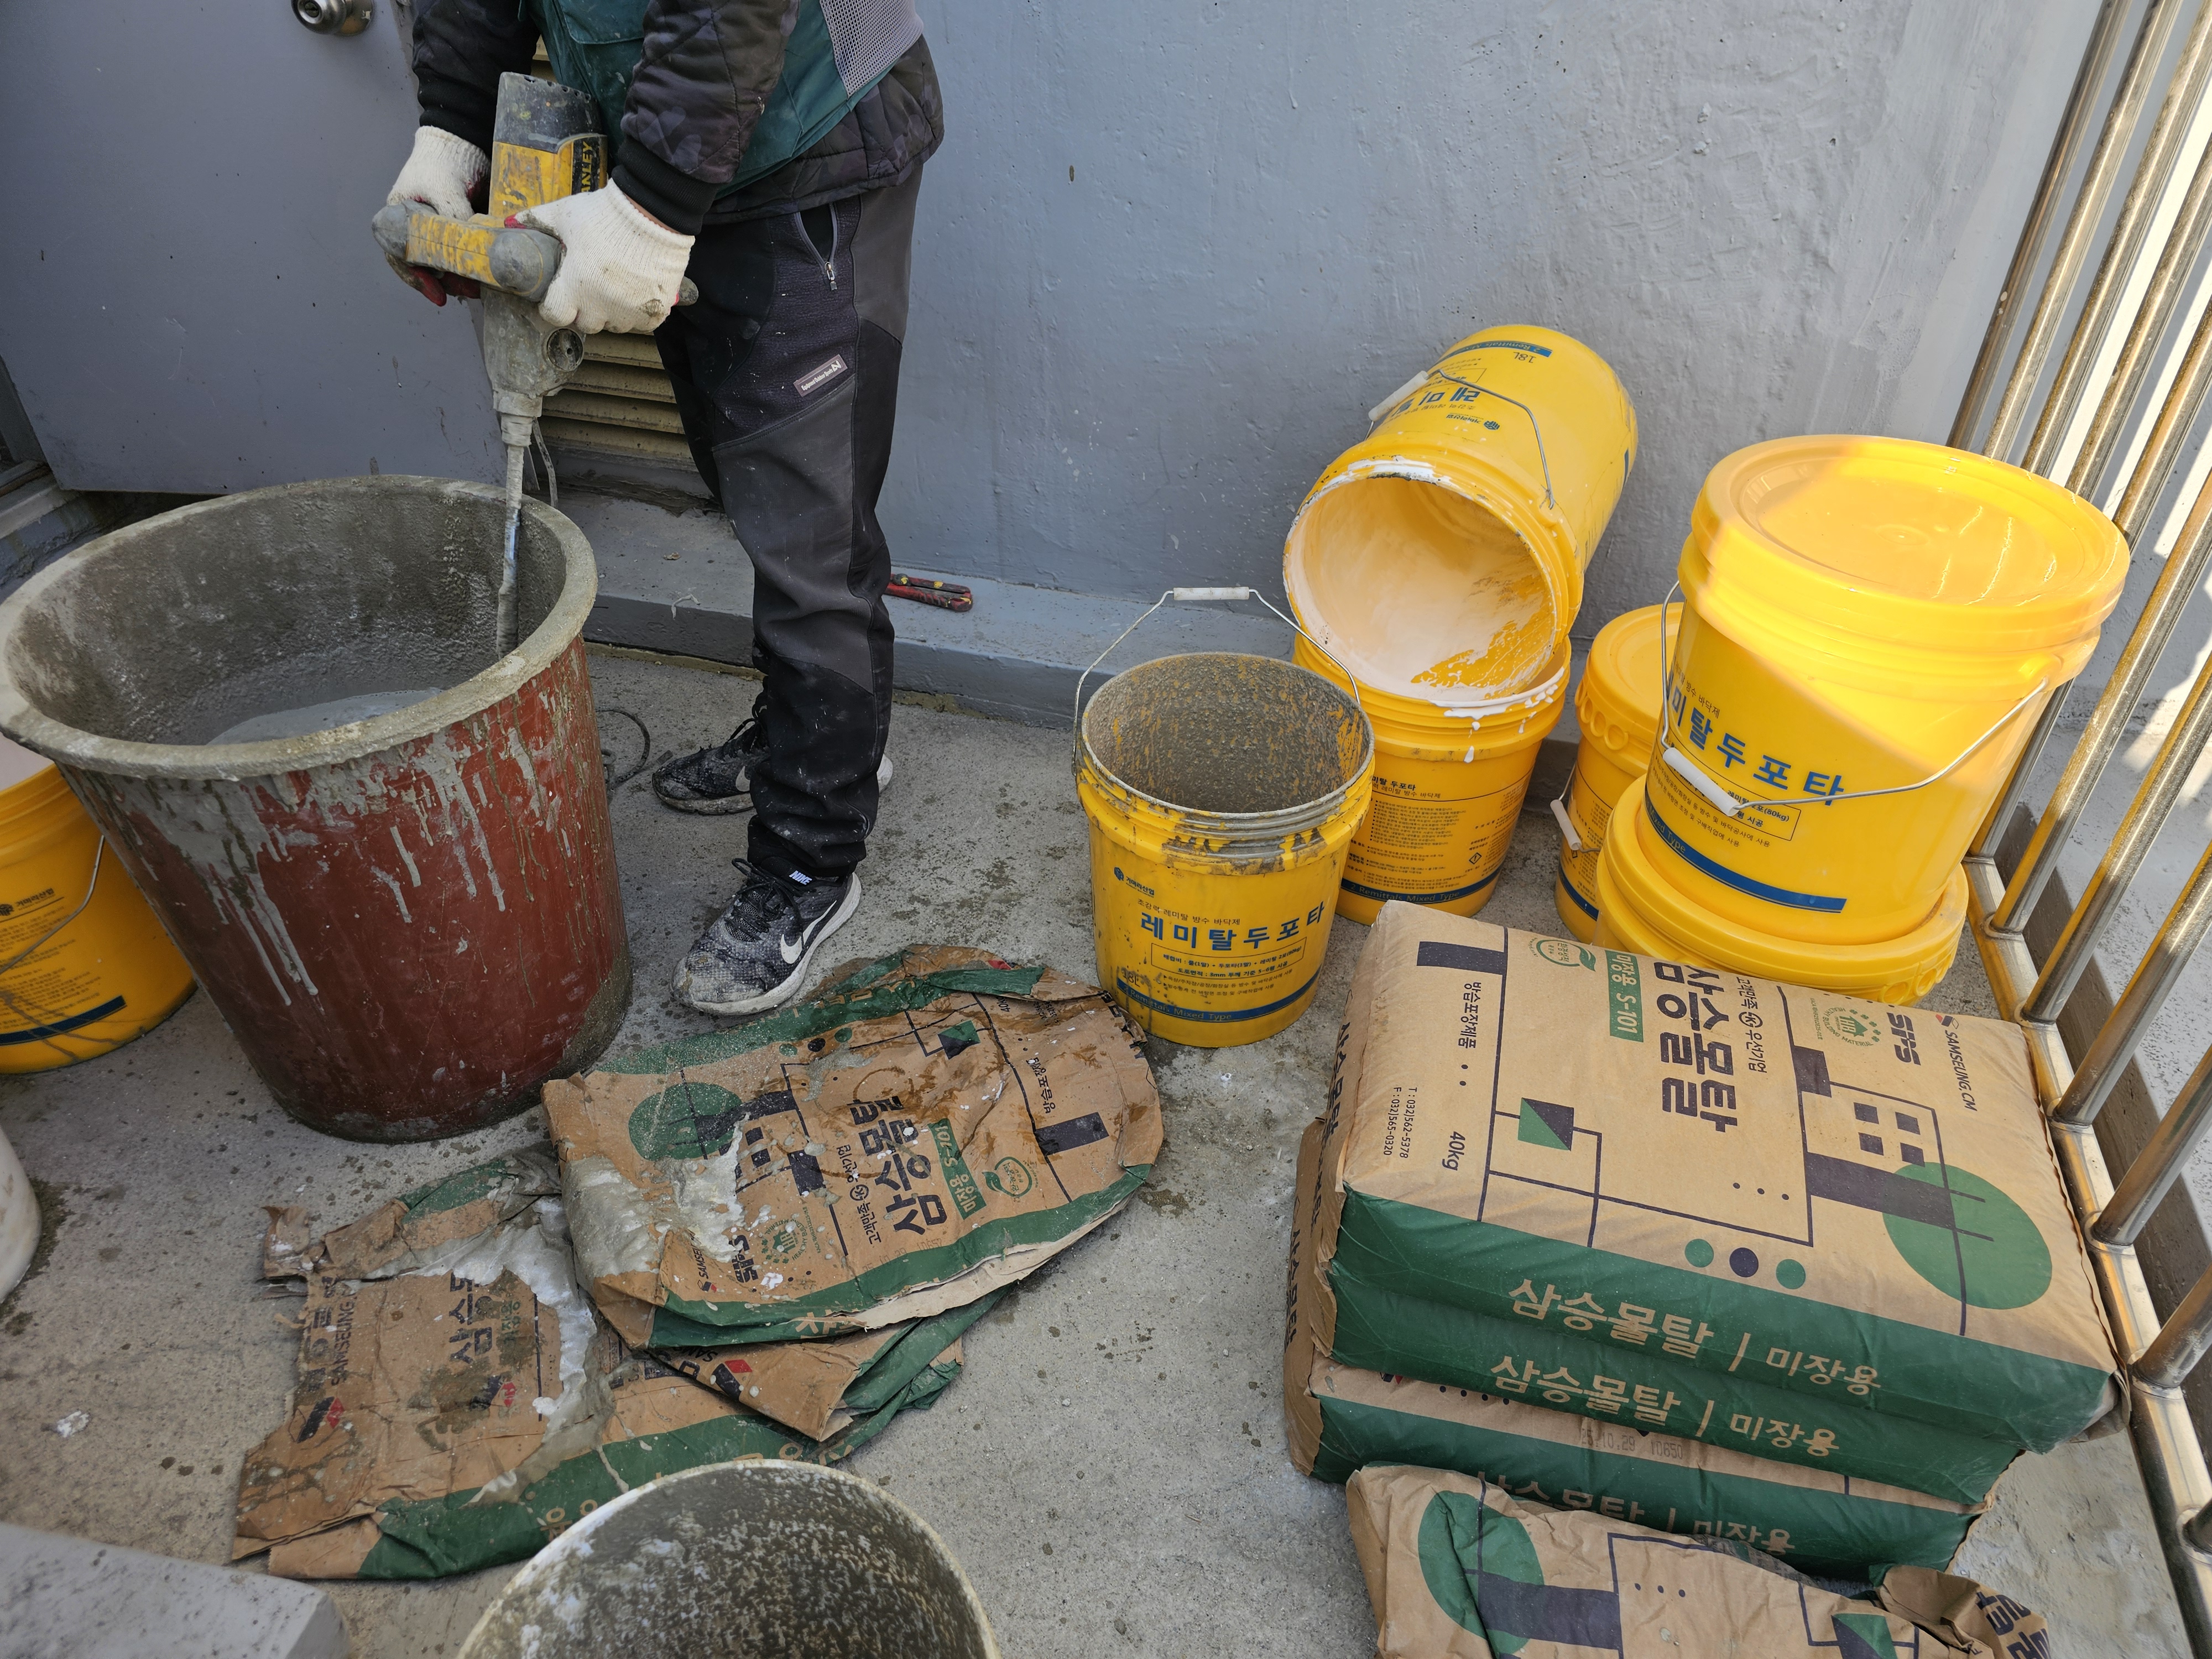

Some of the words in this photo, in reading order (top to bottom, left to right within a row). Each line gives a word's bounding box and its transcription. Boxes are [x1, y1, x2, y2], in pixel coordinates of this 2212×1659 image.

[1514, 352, 1536, 363] 18L
[1686, 680, 1696, 697] 방수
[1698, 695, 1720, 719] 바닥제
[1390, 781, 1416, 791] 두포타
[1720, 820, 1754, 841] 바닥공사에
[1756, 838, 1771, 848] 사용
[1747, 816, 1764, 827] 시공
[1667, 831, 1686, 854] Type
[1727, 837, 1740, 848] 사용
[789, 870, 813, 886] NIKE
[1359, 886, 1402, 901] Remittals
[1406, 894, 1436, 902] Mixed
[1439, 891, 1460, 901] Type
[1164, 909, 1188, 921] 레미탈
[1611, 954, 1637, 986] 미장용
[1173, 1006, 1204, 1019] Mixed
[1736, 977, 1759, 1010] 고객만족
[1458, 982, 1481, 1049] 방습포장제품
[1616, 993, 1638, 1034] S-101
[1653, 962, 1738, 1133] 삼승몰탈
[1745, 1029, 1767, 1073] 우선기업
[1841, 1036, 1874, 1047] MATERIAL
[1886, 1011, 1921, 1066] SPS
[934, 1125, 959, 1168] S-101
[1383, 1098, 1400, 1156] 032)565-0320
[1399, 1099, 1416, 1159] 032)562-5378
[847, 1095, 948, 1236] 삼승몰탈
[1442, 1130, 1467, 1171] 40kg
[949, 1173, 978, 1213] 미장용
[857, 1202, 882, 1245] 고객만족
[1509, 1279, 1715, 1359] 삼승몰탈
[1766, 1346, 1882, 1396] 미장용
[1491, 1355, 1682, 1427] 삼승몰탈
[1730, 1412, 1840, 1457] 미장용
[1650, 1431, 1684, 1461] 10650
